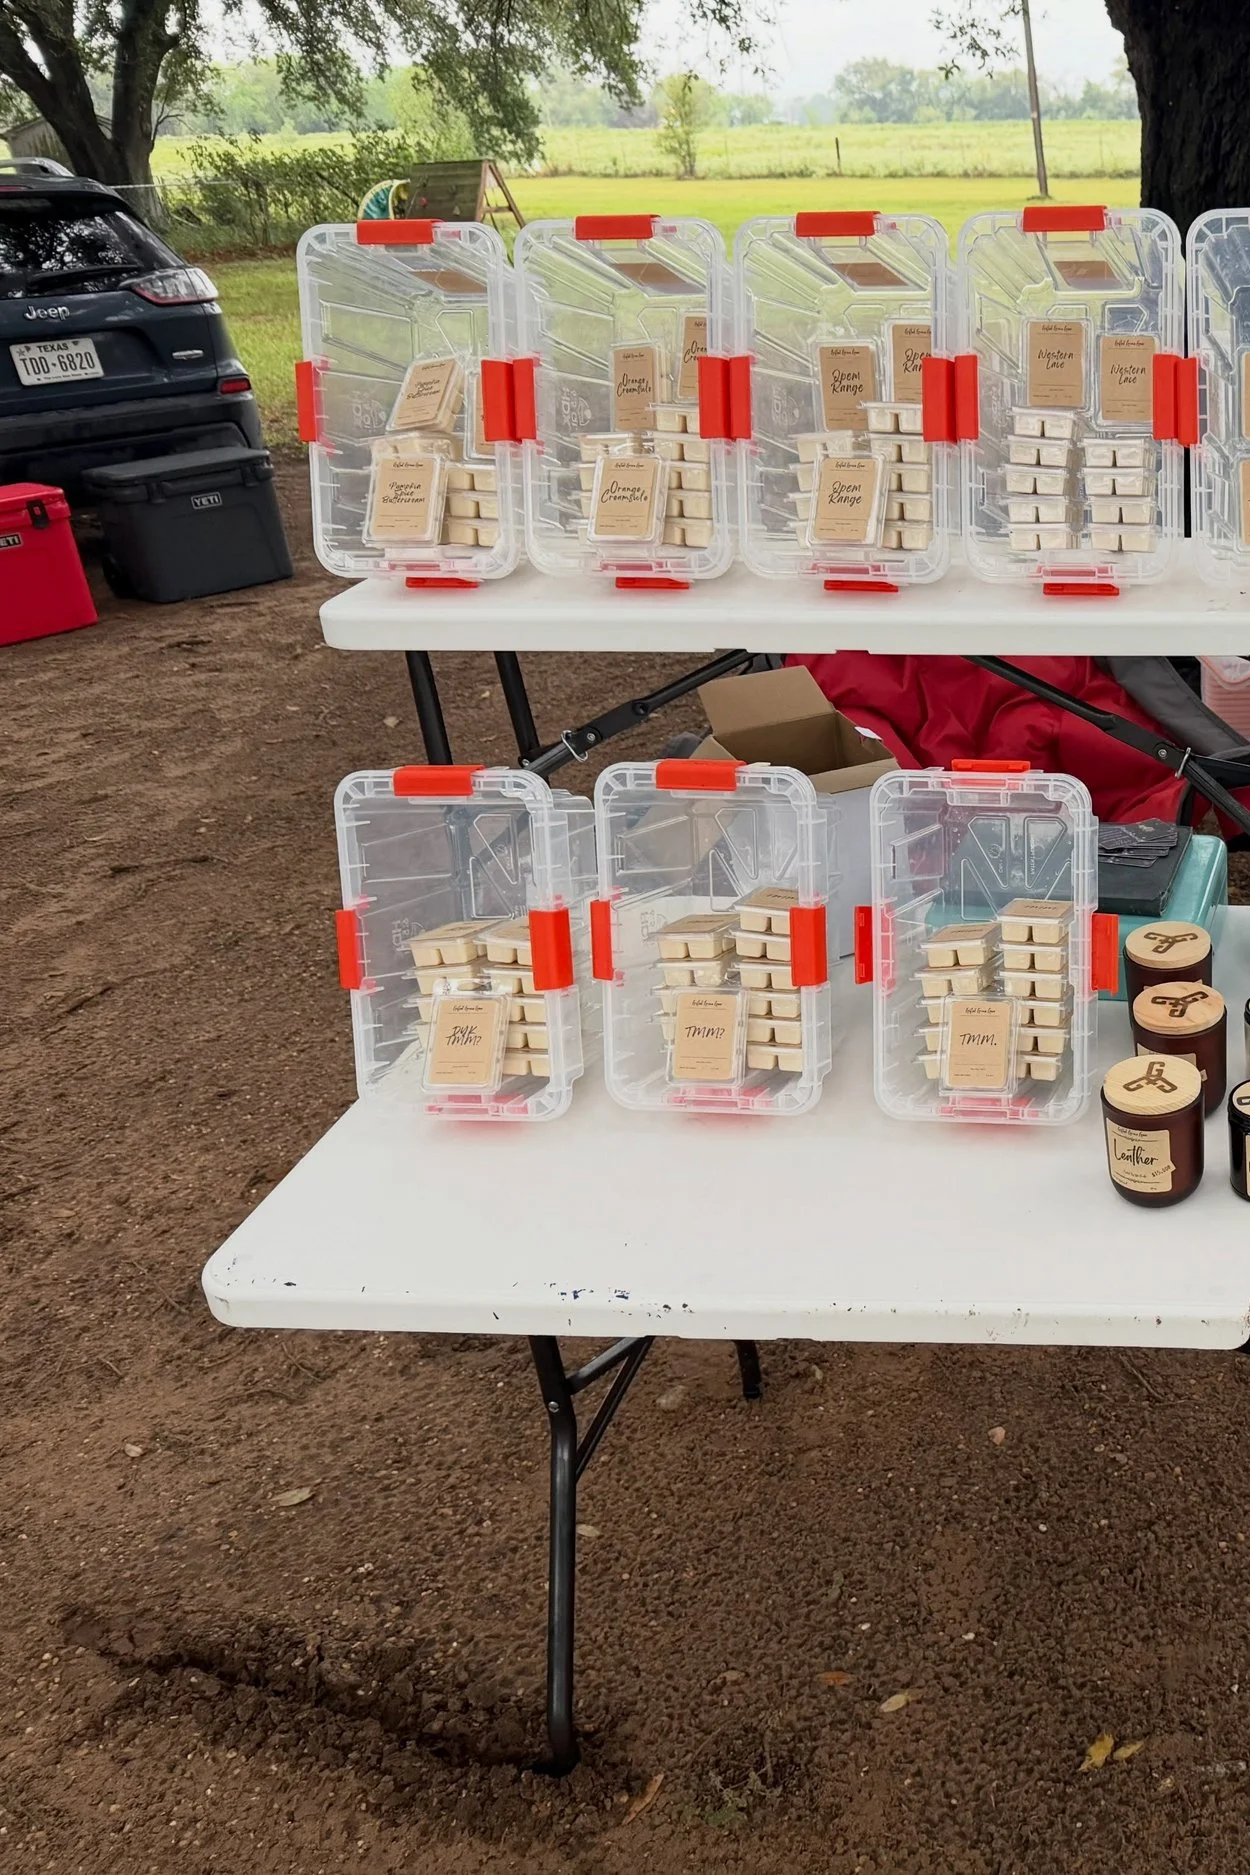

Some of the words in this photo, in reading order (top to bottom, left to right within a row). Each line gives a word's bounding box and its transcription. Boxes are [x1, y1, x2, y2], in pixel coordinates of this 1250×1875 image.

[24, 305, 70, 321] Jeep
[36, 343, 69, 353] TEXAS
[1038, 349, 1074, 360] Western
[1046, 359, 1065, 370] Lace
[1110, 364, 1146, 376] Western
[622, 373, 646, 388] Orange
[831, 369, 860, 386] Open
[1118, 374, 1137, 385] Lace
[830, 380, 864, 396] Range
[610, 480, 642, 496] Orange
[832, 480, 862, 497] Open
[193, 494, 221, 507] YETI
[828, 492, 863, 507] Range
[0, 535, 20, 546] ETI
[685, 1025, 725, 1039] TMM?
[445, 1035, 482, 1046] TMM?
[1112, 1138, 1158, 1166] Leather
